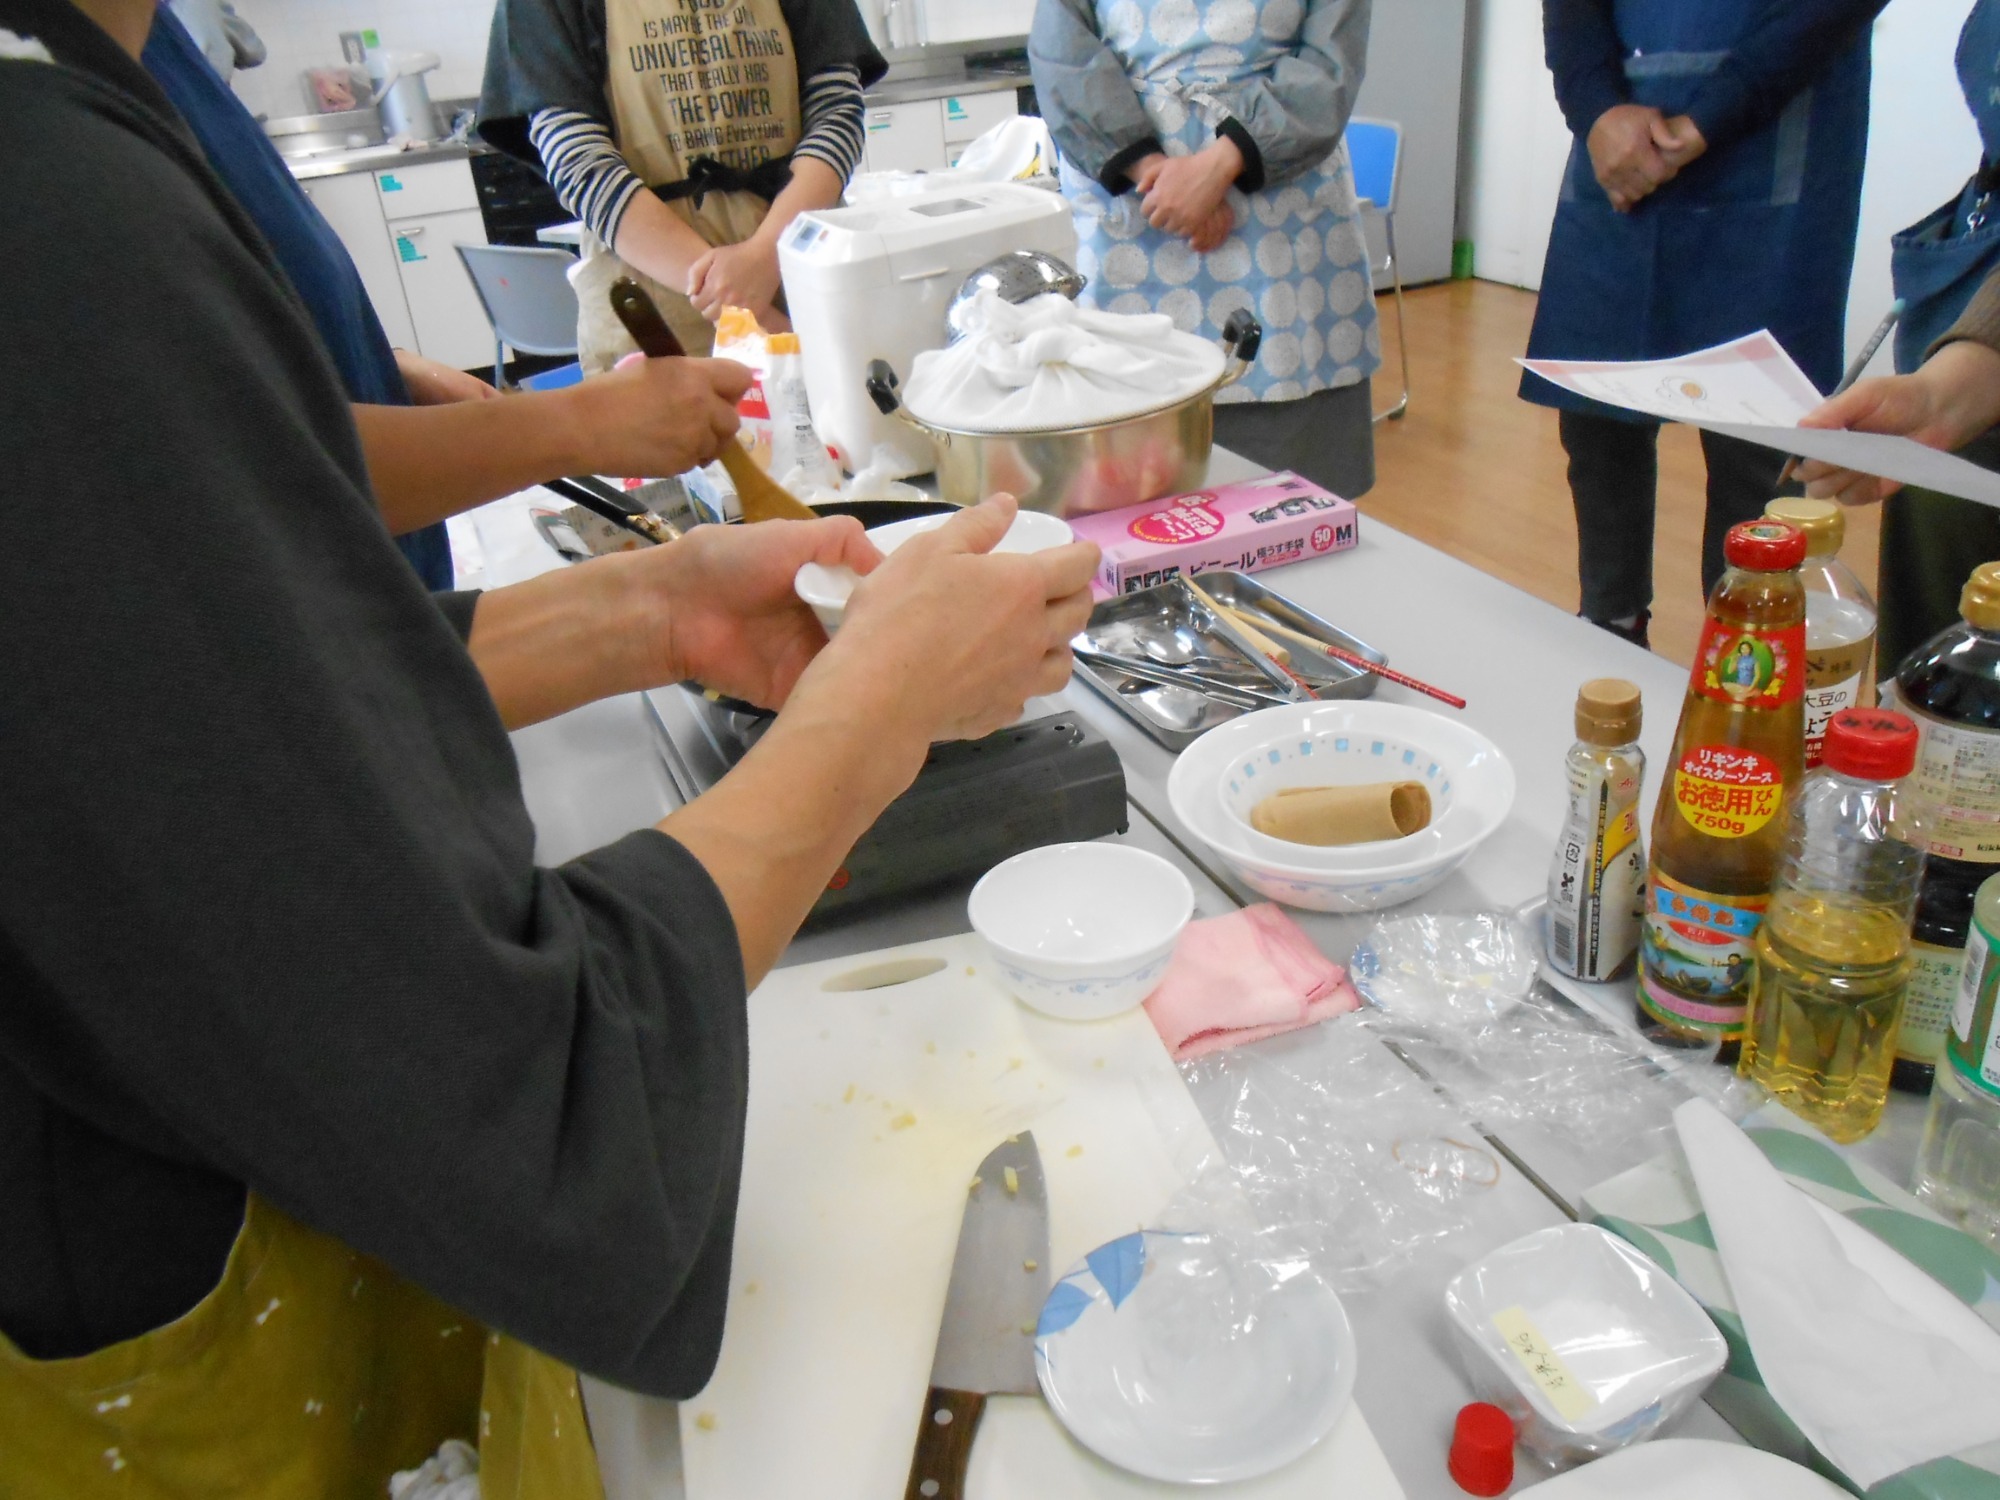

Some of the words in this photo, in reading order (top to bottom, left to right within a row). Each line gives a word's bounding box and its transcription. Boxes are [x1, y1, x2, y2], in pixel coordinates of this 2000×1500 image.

[643, 21, 658, 38] IS
[705, 13, 729, 30] THE
[629, 33, 736, 72] UNIVERSAL
[733, 29, 784, 58] THING
[660, 71, 694, 93] THAT
[698, 65, 741, 90] REALLY
[744, 63, 769, 83] HAS
[667, 95, 706, 125] THE
[708, 88, 773, 122] POWER
[667, 132, 681, 152] TO
[684, 126, 722, 149] BRING
[726, 120, 785, 143] EVERYONE
[1315, 529, 1331, 545] 50
[1336, 524, 1352, 540] M
[1684, 760, 1773, 784] オイスターソース
[1700, 748, 1759, 770] リキンキ
[1677, 777, 1753, 816] お徳用
[1692, 811, 1745, 835] 750g
